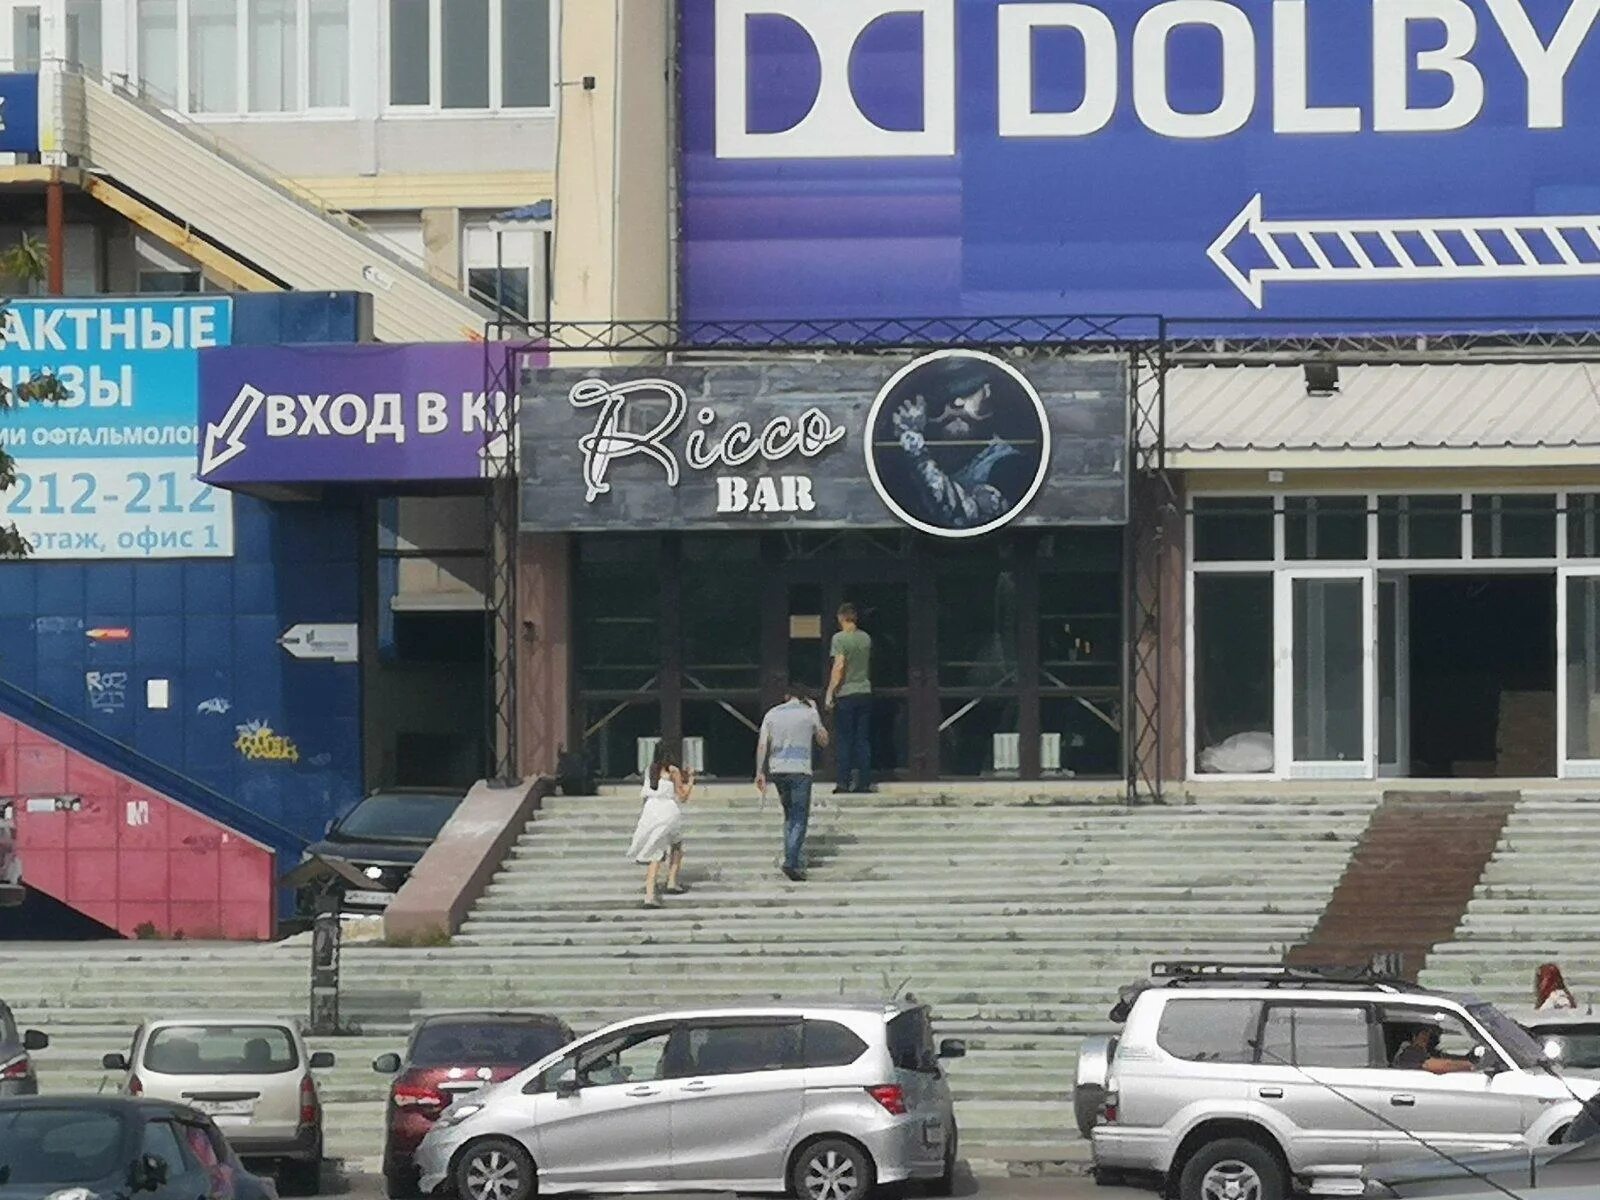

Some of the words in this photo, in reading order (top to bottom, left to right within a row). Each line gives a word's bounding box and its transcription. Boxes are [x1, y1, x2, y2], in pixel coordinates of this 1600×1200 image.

[999, 0, 1600, 137] DOLBY
[266, 394, 405, 443] ВХОД
[417, 393, 448, 434] В
[569, 378, 845, 503] Ricco
[716, 476, 815, 513] BAR
[117, 525, 192, 555] офис
[204, 525, 218, 548] 1
